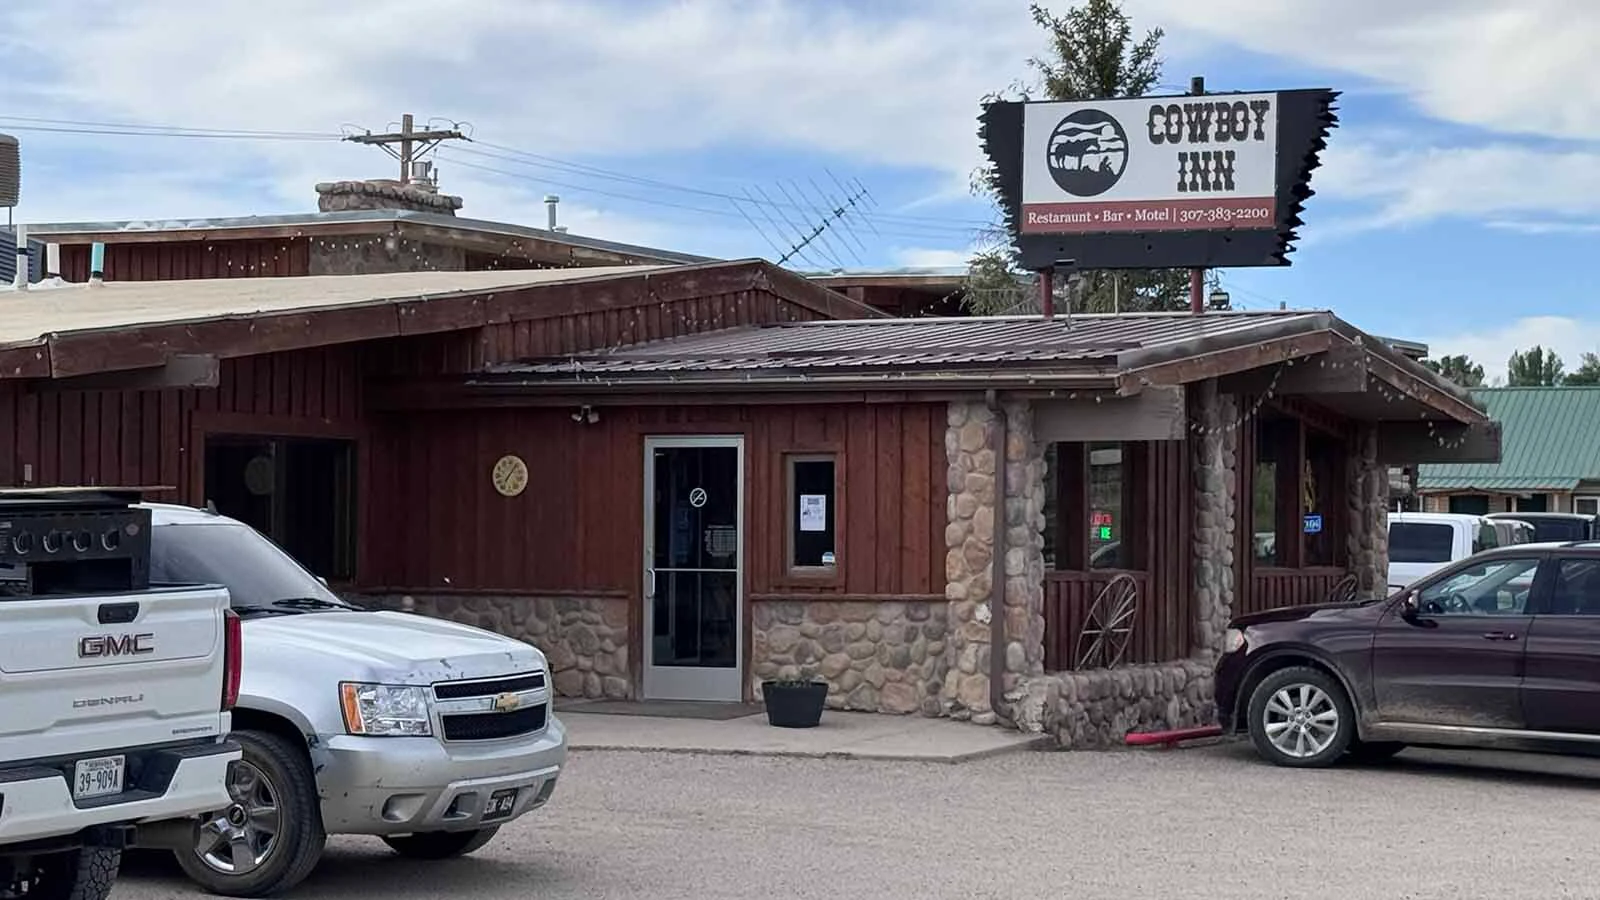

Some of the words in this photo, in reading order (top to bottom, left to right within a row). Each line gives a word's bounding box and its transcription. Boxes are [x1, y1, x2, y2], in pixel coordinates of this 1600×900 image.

[1146, 100, 1270, 144] COWBOY
[1177, 150, 1236, 192] INN
[1028, 212, 1091, 225] Restaraunt
[1103, 210, 1123, 222] Bar
[1134, 207, 1169, 221] Motel
[1180, 207, 1269, 222] 307-383-2200
[79, 633, 154, 658] GMC
[72, 694, 144, 708] DENALI
[79, 768, 118, 792] 39-909A
